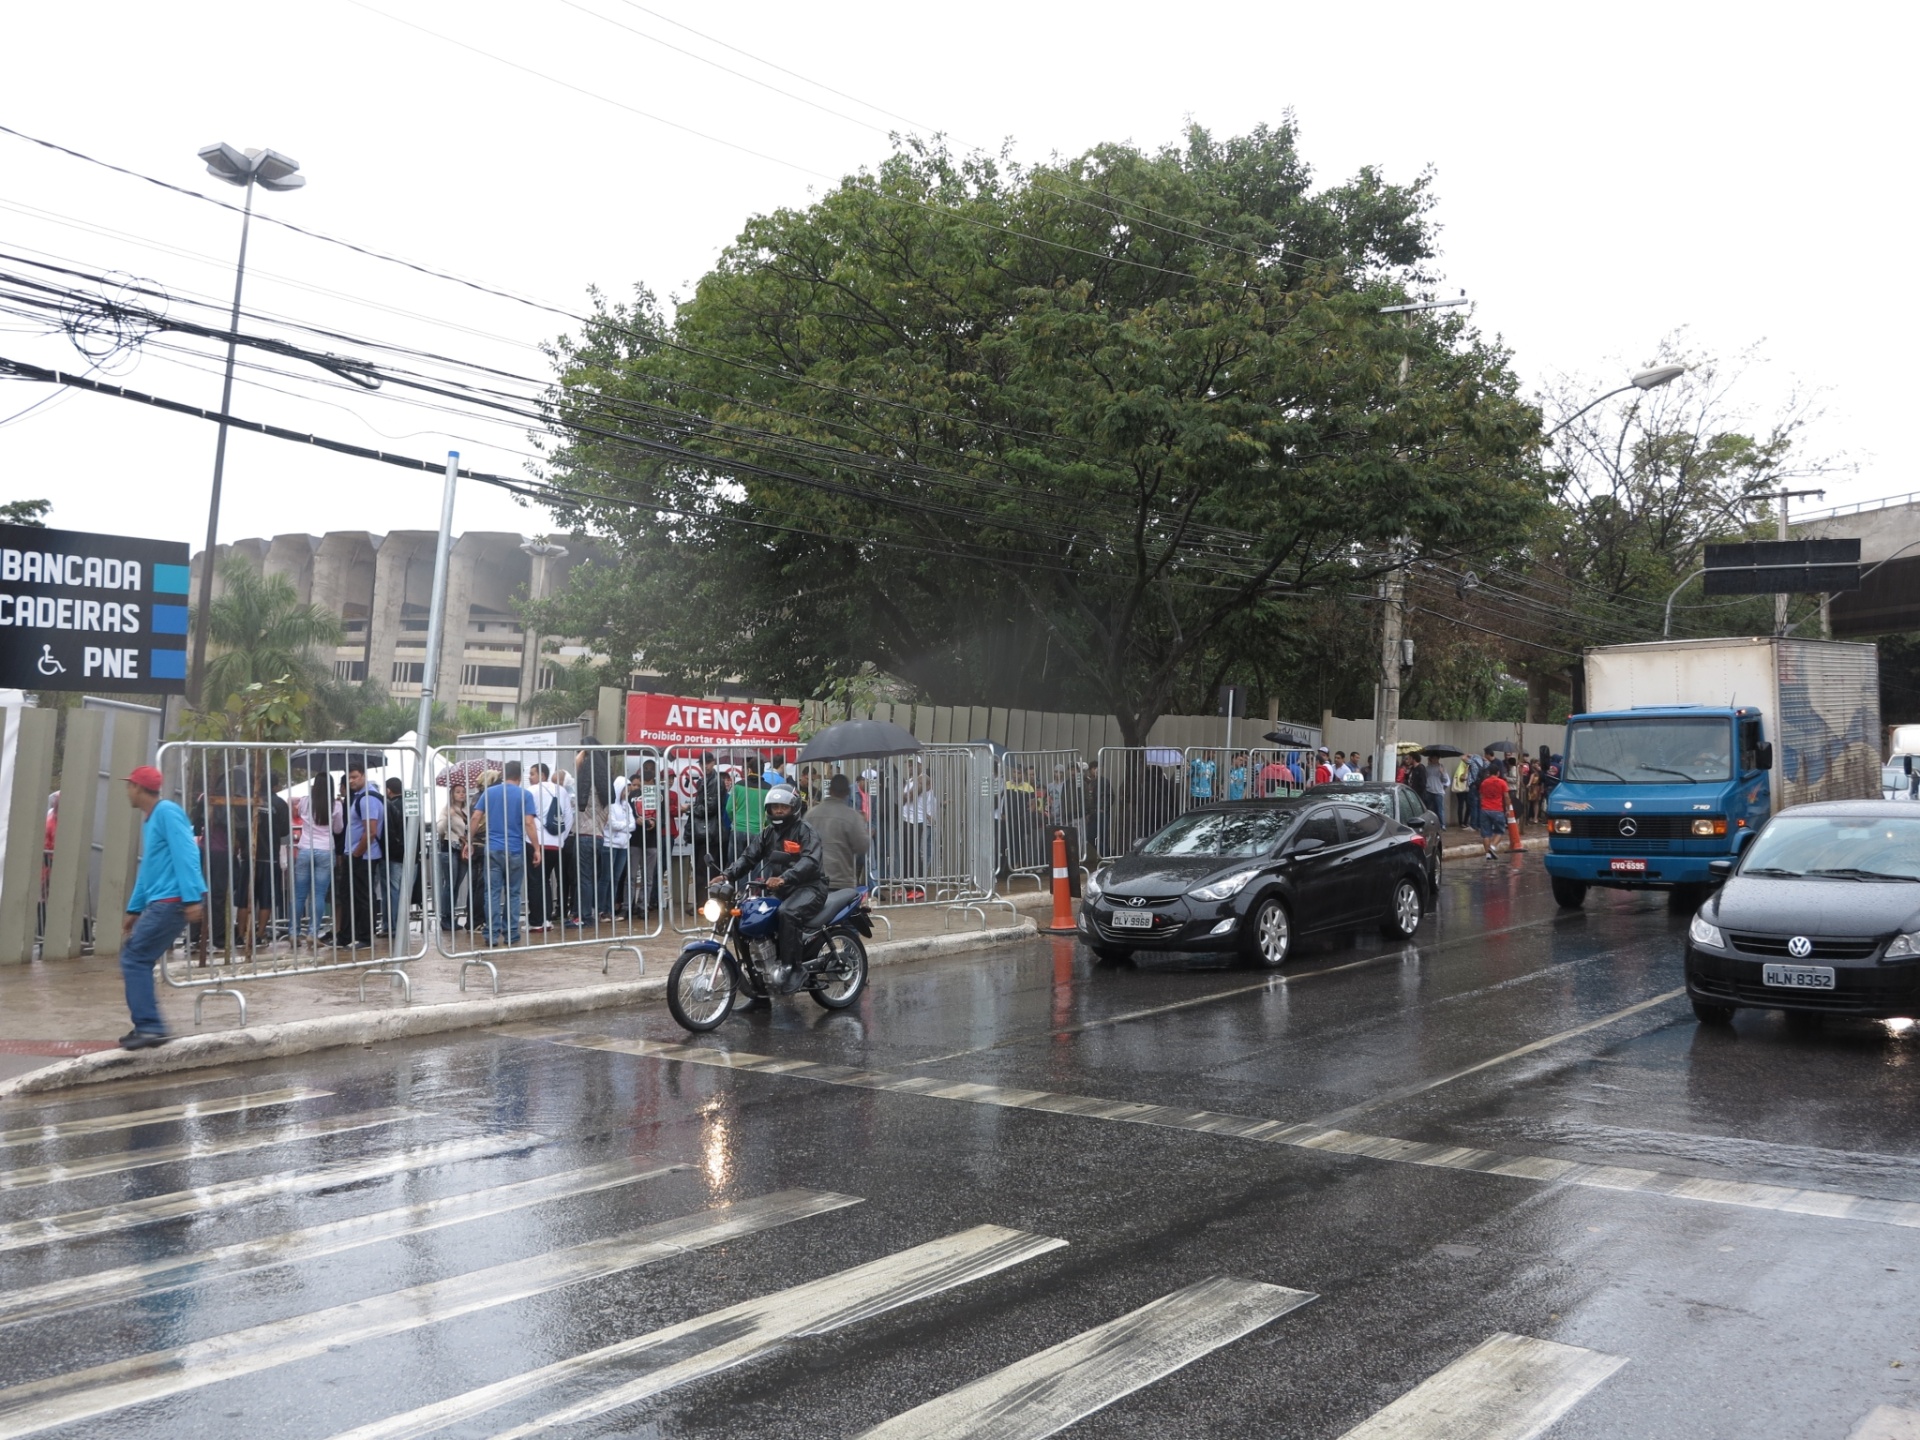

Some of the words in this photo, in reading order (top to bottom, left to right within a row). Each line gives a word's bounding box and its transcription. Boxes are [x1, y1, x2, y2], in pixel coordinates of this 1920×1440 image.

[0, 548, 141, 591] BANCADA
[0, 594, 140, 634] CADEIRAS
[83, 646, 139, 679] PNE
[640, 729, 682, 743] Proibido
[684, 733, 713, 745] portar
[716, 737, 728, 745] os
[665, 704, 781, 737] ATENÇÃO
